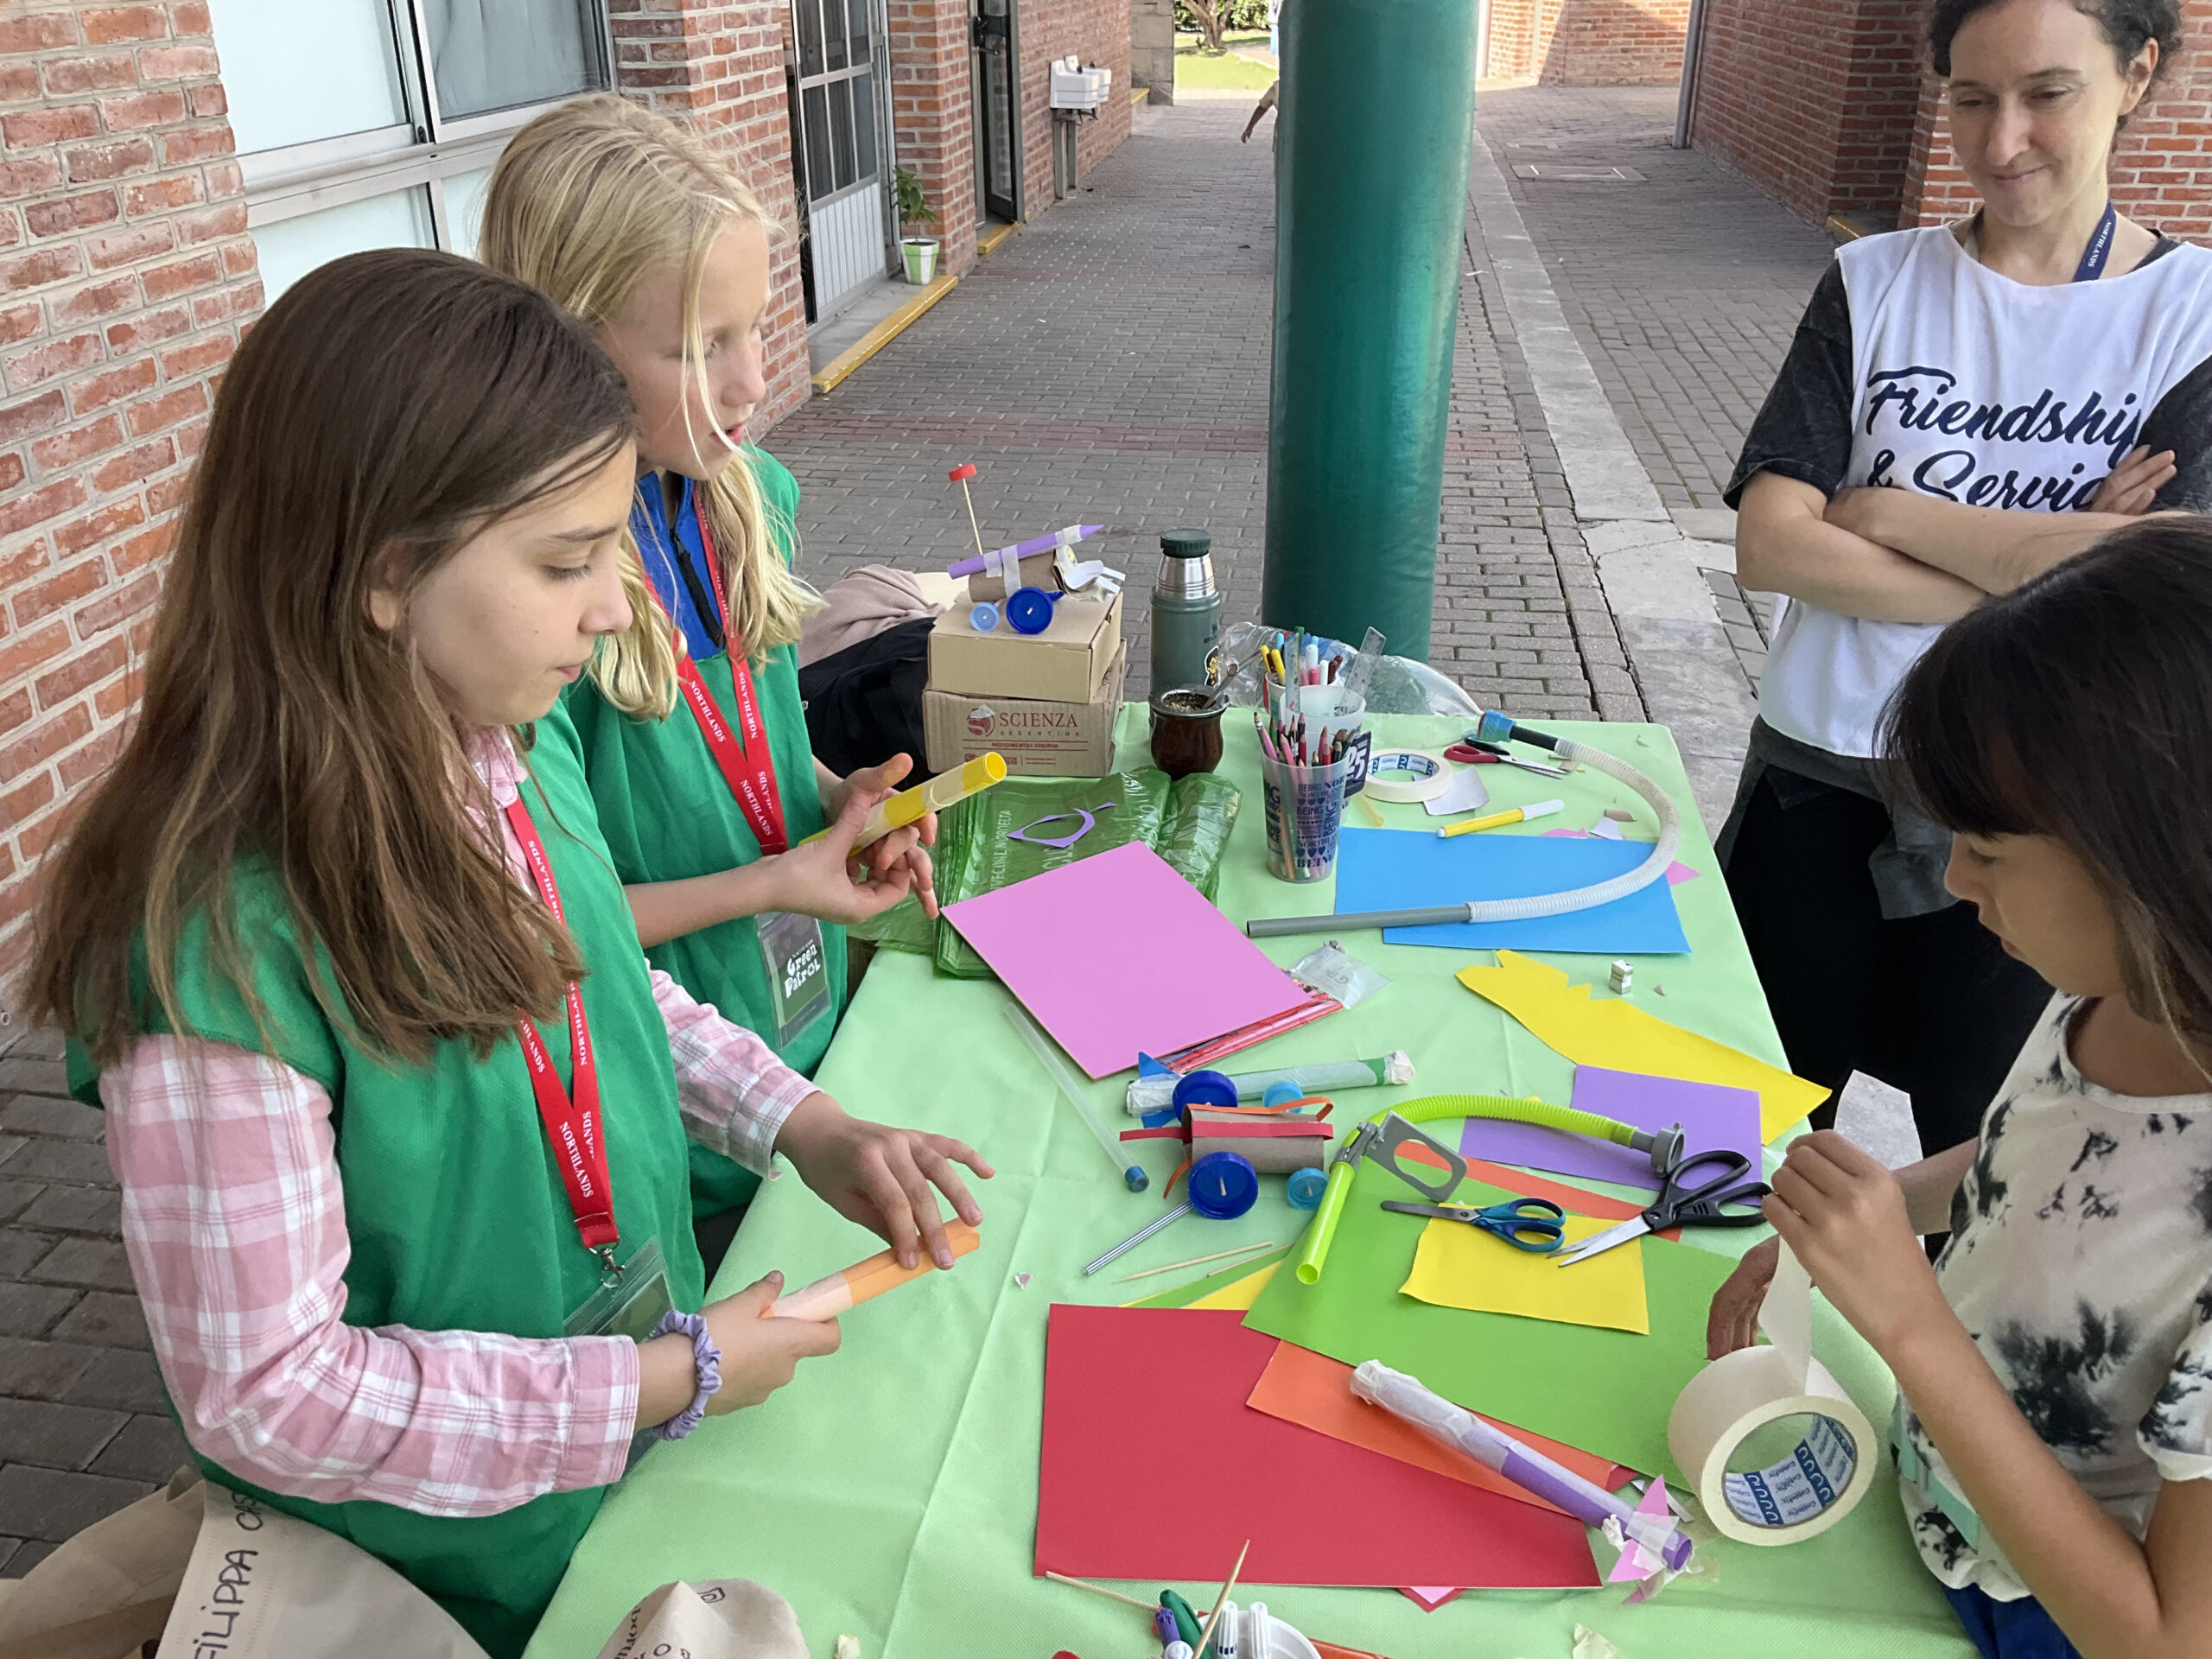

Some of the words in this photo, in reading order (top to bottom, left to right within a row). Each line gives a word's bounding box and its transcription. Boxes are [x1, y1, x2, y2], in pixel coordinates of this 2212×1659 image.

[1866, 449, 1896, 488] &
[690, 681, 726, 742] NORTHLANDS
[738, 671, 758, 739] NORTHLANDS
[999, 712, 1078, 728] SCIENZA
[741, 779, 772, 836] NORTHLANDS
[528, 841, 561, 920] ORTHLANDS
[786, 944, 817, 977] Green
[570, 982, 587, 1066] NORTHLAND
[559, 1122, 594, 1198] NORTHLANDS
